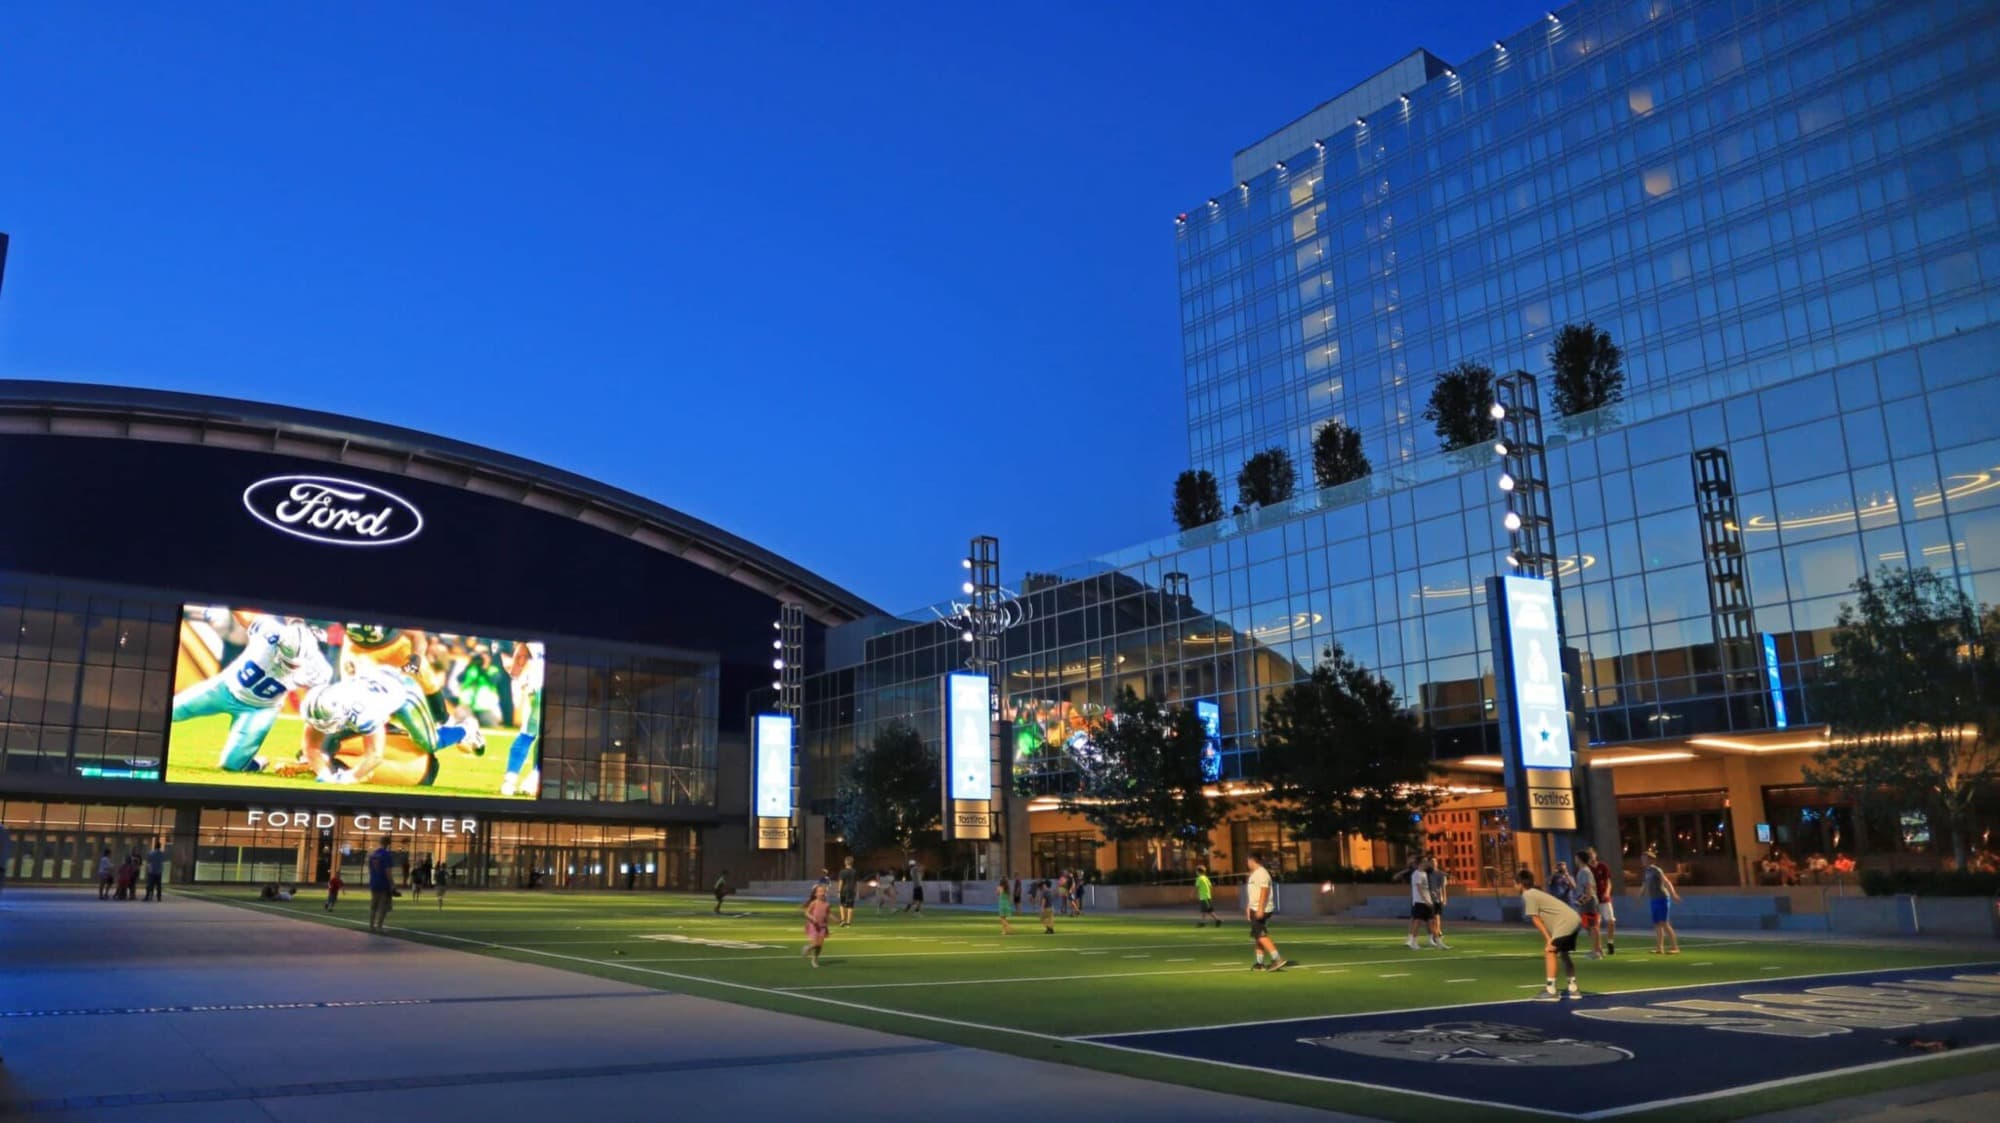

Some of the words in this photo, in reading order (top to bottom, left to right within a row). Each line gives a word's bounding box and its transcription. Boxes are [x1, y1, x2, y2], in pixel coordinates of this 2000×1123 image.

[275, 482, 393, 536] Ford
[1532, 790, 1571, 806] Tostitos
[247, 809, 336, 829] FORD
[354, 814, 478, 834] CENTER
